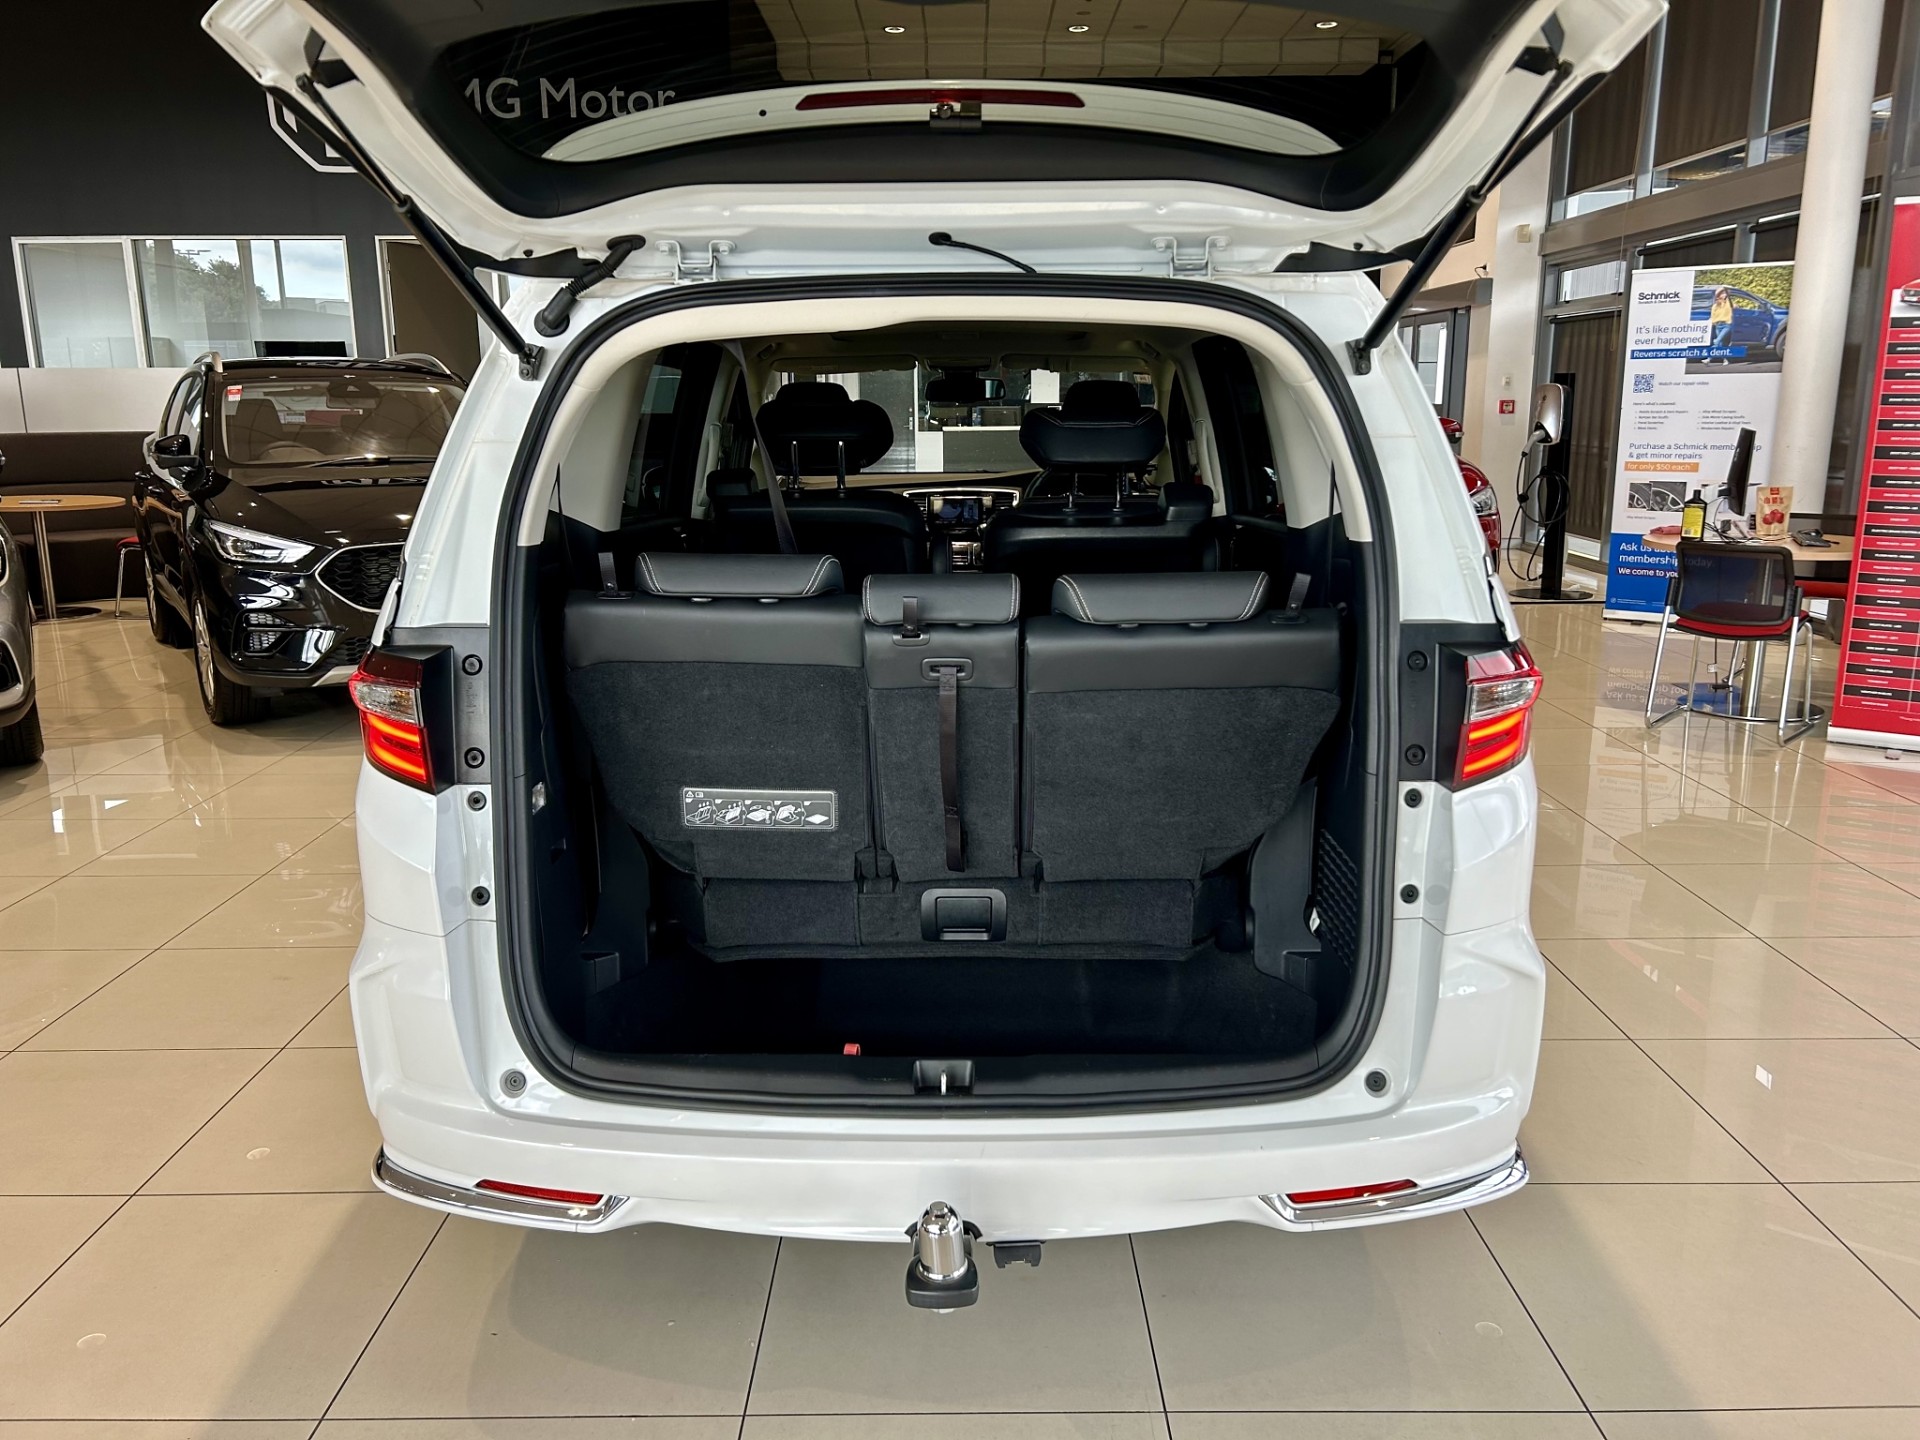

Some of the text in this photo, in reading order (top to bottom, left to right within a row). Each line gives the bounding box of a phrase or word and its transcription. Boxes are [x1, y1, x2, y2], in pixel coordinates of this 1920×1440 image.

[539, 77, 676, 119] Motor
[1638, 291, 1681, 301] Schmick
[1652, 325, 1669, 334] like
[1671, 324, 1709, 334] nothing
[1634, 335, 1707, 346] ever happened.
[1633, 350, 1666, 358] Reverse
[1668, 349, 1700, 357] scratch
[1629, 442, 1665, 451] Purchase
[1673, 443, 1708, 451] Schmick
[1710, 443, 1762, 452] membip
[1635, 452, 1649, 460] get
[1674, 452, 1702, 460] repairs
[1656, 463, 1671, 471] $50
[1620, 542, 1638, 551] Ask
[1618, 567, 1631, 575] We
[1631, 568, 1654, 576] come
[1655, 569, 1664, 577] to
